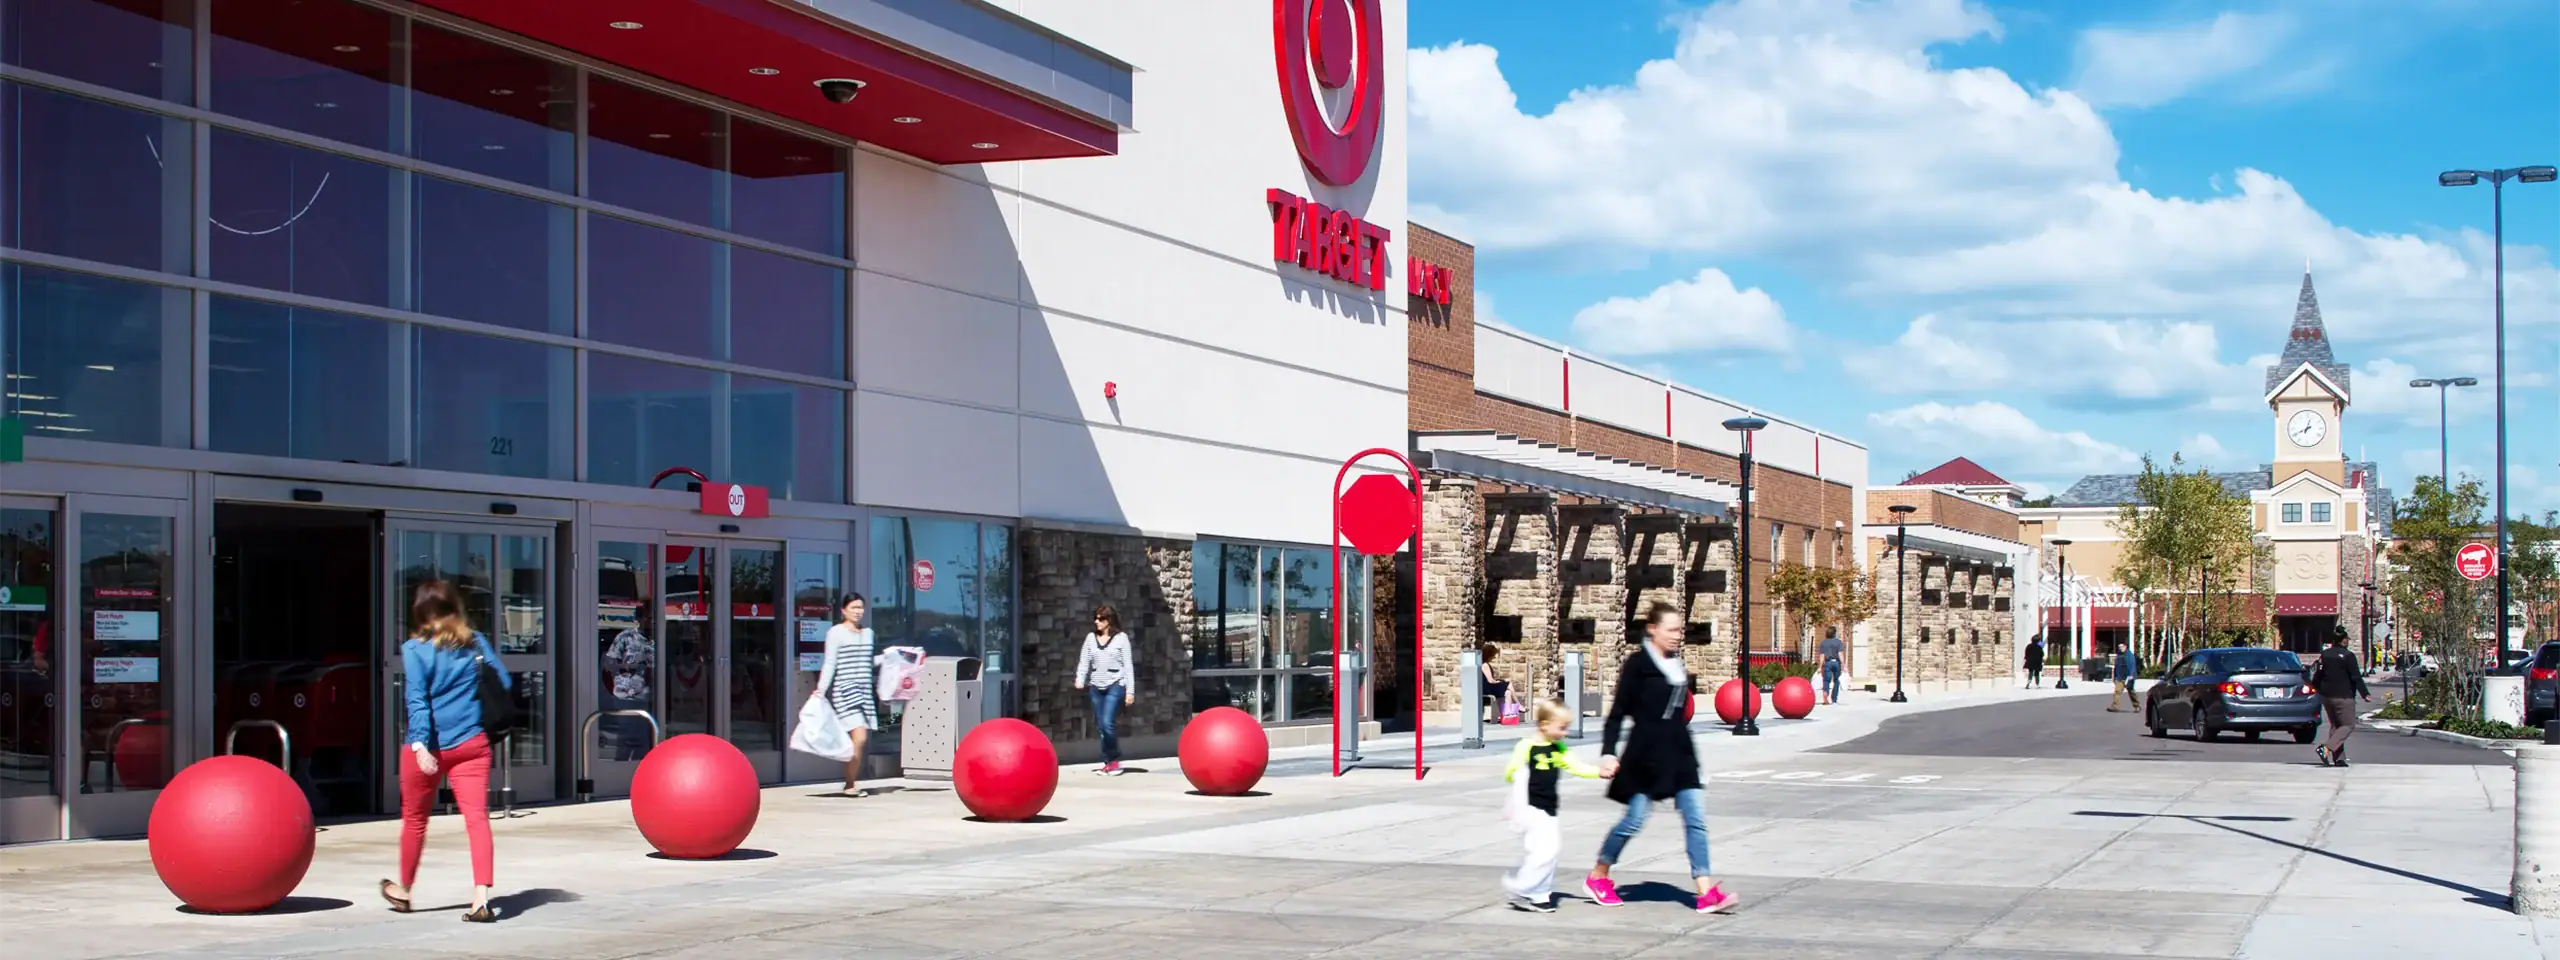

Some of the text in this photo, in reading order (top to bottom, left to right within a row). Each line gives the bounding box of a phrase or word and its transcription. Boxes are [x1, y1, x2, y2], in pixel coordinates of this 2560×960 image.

[1267, 188, 1390, 291] TARGET
[491, 436, 513, 458] 221
[729, 493, 744, 506] OUT
